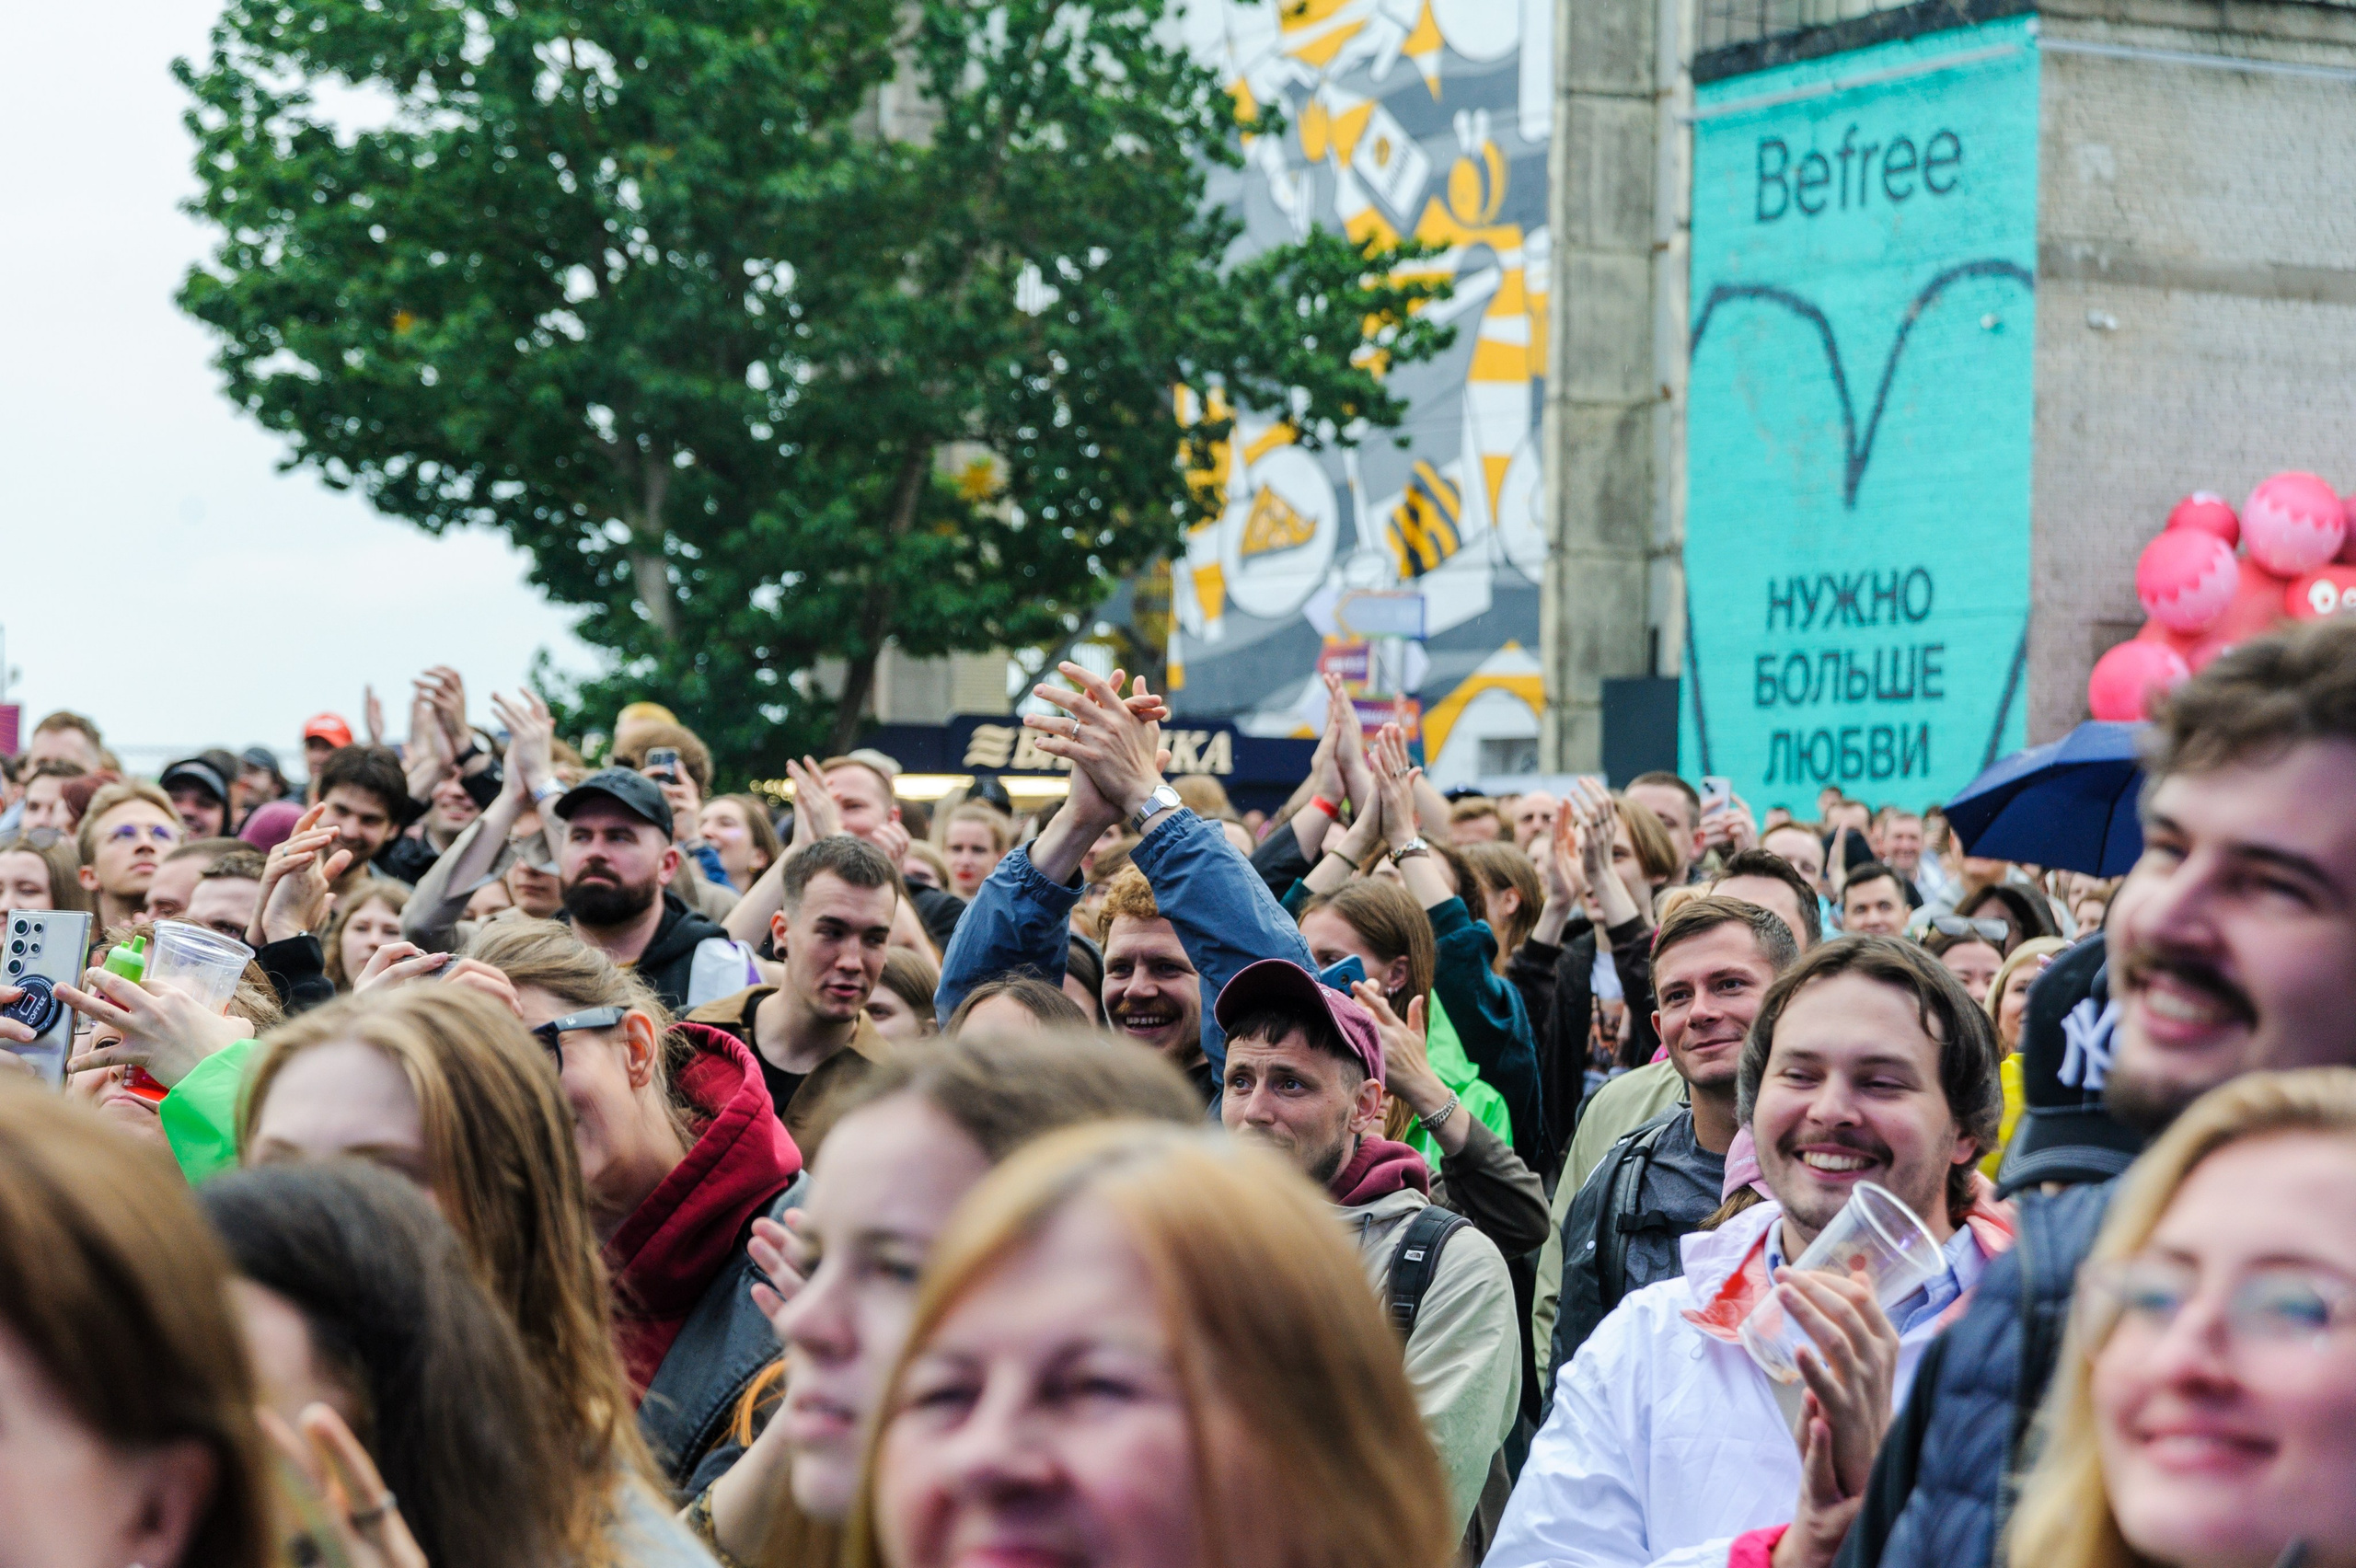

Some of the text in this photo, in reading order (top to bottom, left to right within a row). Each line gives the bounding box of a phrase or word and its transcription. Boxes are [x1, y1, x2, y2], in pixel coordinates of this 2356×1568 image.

[1756, 123, 1961, 222] Befree
[1766, 566, 1933, 632] НУЖНО
[1755, 643, 1944, 708] БОЛЬШЕ
[1764, 722, 1929, 783] ЛЮБВИ
[27, 995, 48, 1024] COFFEE
